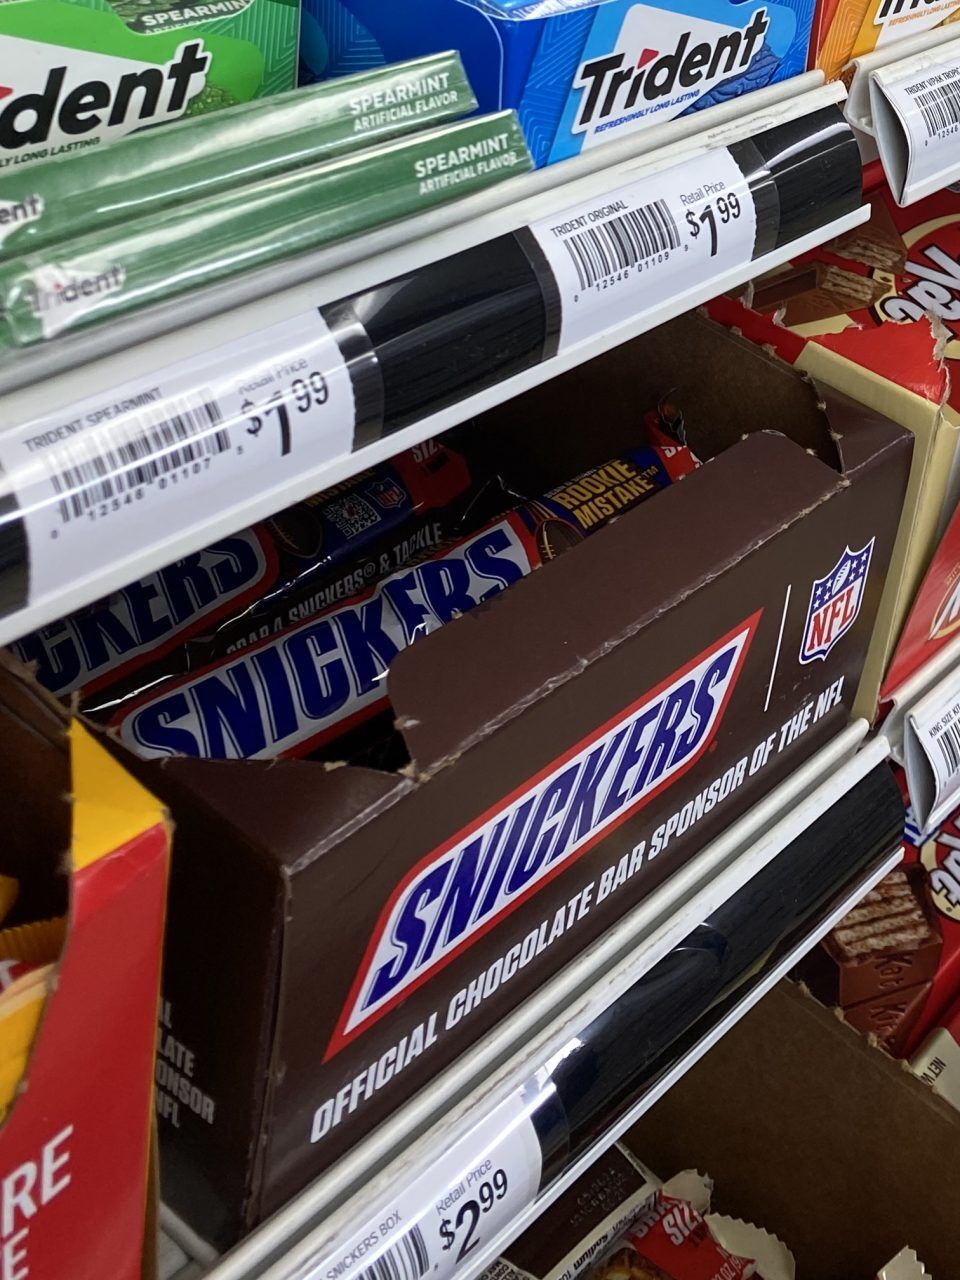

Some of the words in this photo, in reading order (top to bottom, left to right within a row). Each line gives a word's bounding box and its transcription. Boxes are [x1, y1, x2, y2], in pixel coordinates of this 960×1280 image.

[350, 71, 452, 116] SPEARMINT
[579, 8, 769, 126] Trident
[353, 105, 414, 133] ARTIFICIAL
[414, 91, 459, 118] FLAVOR
[15, 147, 48, 166] LONG
[49, 136, 101, 159] LASTING
[413, 132, 511, 179] SPEARMINT
[418, 164, 477, 197] ARTIFICIAL
[476, 151, 518, 179] FLAVOR
[551, 216, 588, 239] TRIDENT
[588, 200, 630, 223] ORIGINAL
[679, 187, 706, 206] Retail
[705, 180, 727, 199] Price
[23, 419, 87, 453] TRIDENT
[85, 386, 164, 427] SPEARMINT
[551, 458, 638, 511] ROOKIE
[134, 528, 525, 760] SNICKERS
[805, 587, 858, 654] NFL
[928, 721, 942, 739] KING
[941, 710, 953, 726] SIZE
[362, 646, 740, 1011] SNICKERS
[310, 1011, 439, 1144] OFFICIAL
[445, 887, 595, 1031] CHOCOLATE
[595, 840, 645, 905] BAR
[647, 762, 746, 859] SPONSOR
[748, 738, 779, 776] OF
[778, 713, 812, 752] THE
[811, 675, 846, 726] NFL
[435, 1183, 467, 1217] Retail
[465, 1158, 493, 1188] Price
[326, 1231, 380, 1280] SNICKERS
[379, 1210, 403, 1237] BOX
